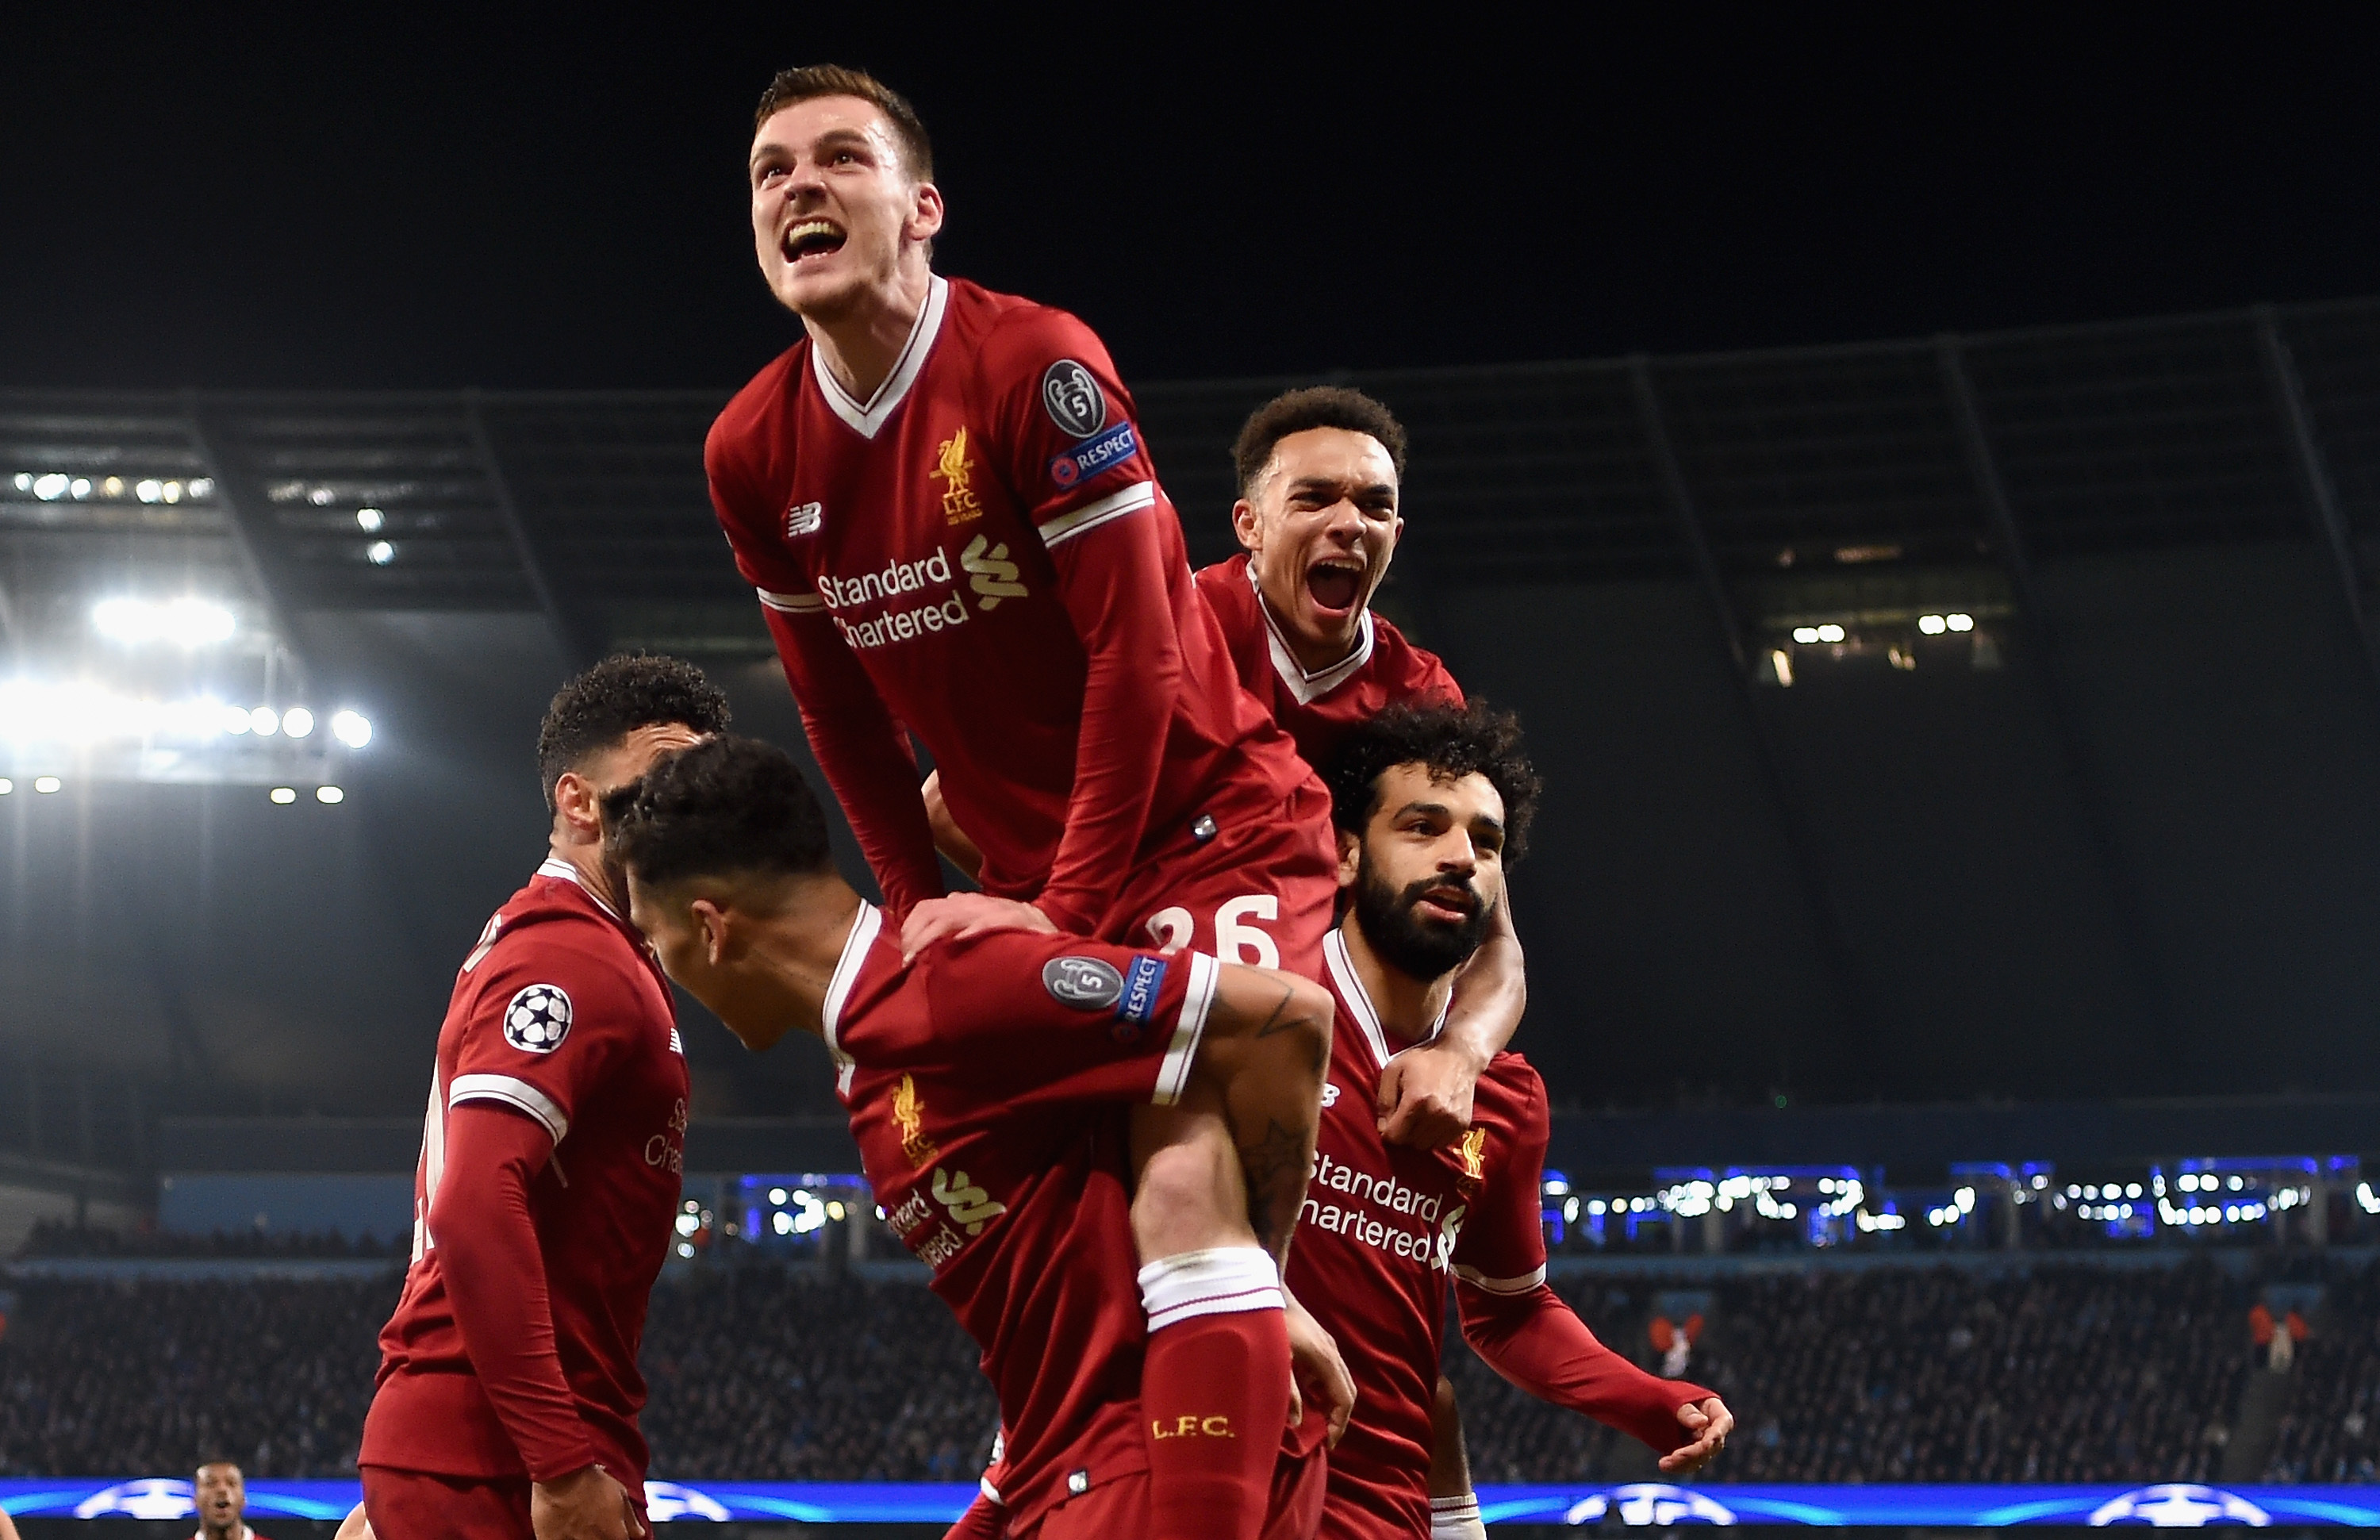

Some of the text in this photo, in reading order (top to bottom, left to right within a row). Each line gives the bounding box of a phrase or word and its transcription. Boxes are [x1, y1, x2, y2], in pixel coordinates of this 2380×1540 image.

[1072, 395, 1088, 417] 5
[1077, 428, 1134, 470] RESPECT
[818, 545, 952, 609] Standard
[1146, 894, 1279, 970] 26
[1081, 974, 1102, 989] 5
[1125, 956, 1157, 1023] RESPECT
[1296, 1199, 1431, 1263] hartered
